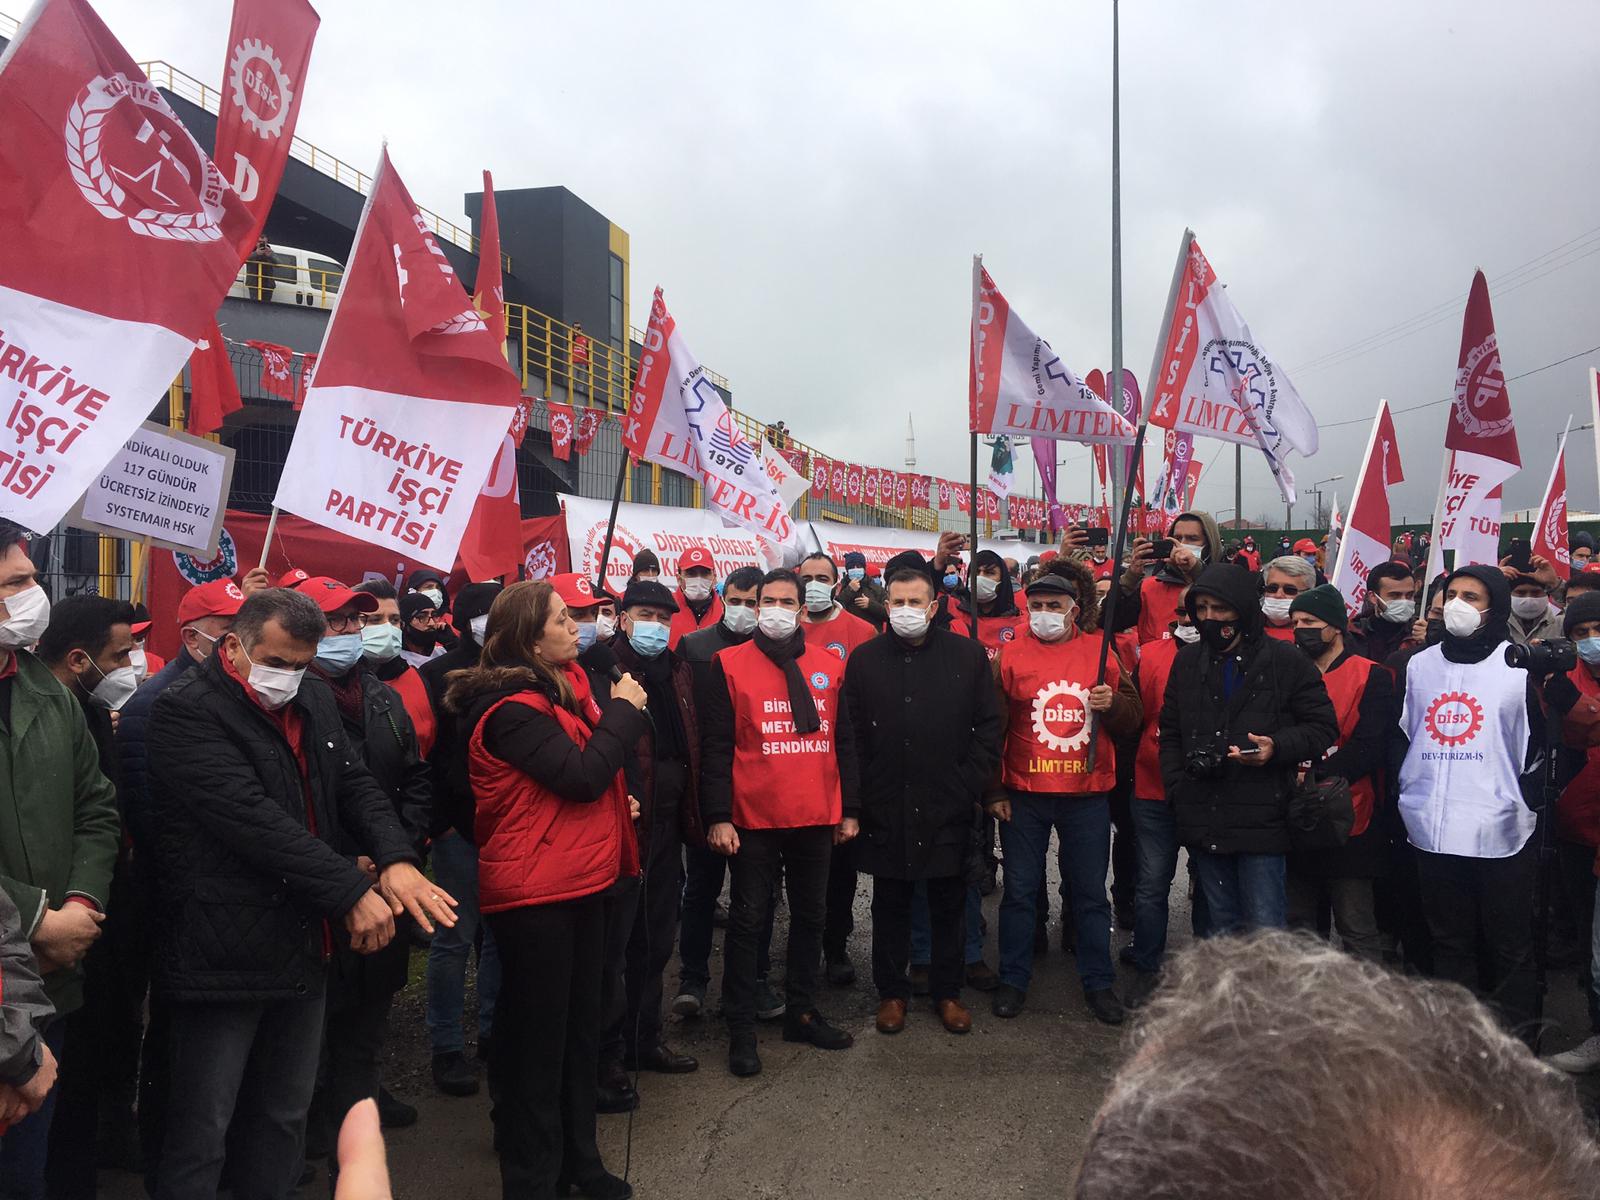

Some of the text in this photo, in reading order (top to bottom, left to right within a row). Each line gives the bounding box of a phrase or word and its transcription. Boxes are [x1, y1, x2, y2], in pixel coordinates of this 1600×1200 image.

[102, 77, 160, 105] TÜİYE
[245, 67, 279, 111] DİSK
[0, 330, 111, 422] RKİYE
[5, 390, 89, 455] İŞÇİ
[122, 439, 209, 475] NDİKALI OLDUK
[340, 414, 463, 484] TÜRKİYE
[708, 449, 745, 476] 1976
[123, 461, 197, 493] 117 GÜNDÜR
[765, 456, 788, 485] İSK
[100, 474, 210, 518] ÜCRETSİZ İZİNDEYİZ
[387, 466, 453, 516] İŞÇİ
[105, 502, 196, 536] SYSTEMAIR HSK
[325, 488, 438, 551] PARTİSİ
[707, 533, 757, 557] DİRENE
[1044, 703, 1085, 723] DİSK
[1436, 710, 1470, 724] DİSK
[762, 738, 830, 755] SENDİKASI
[1421, 750, 1485, 763] DEV-TURİZM-İŞ
